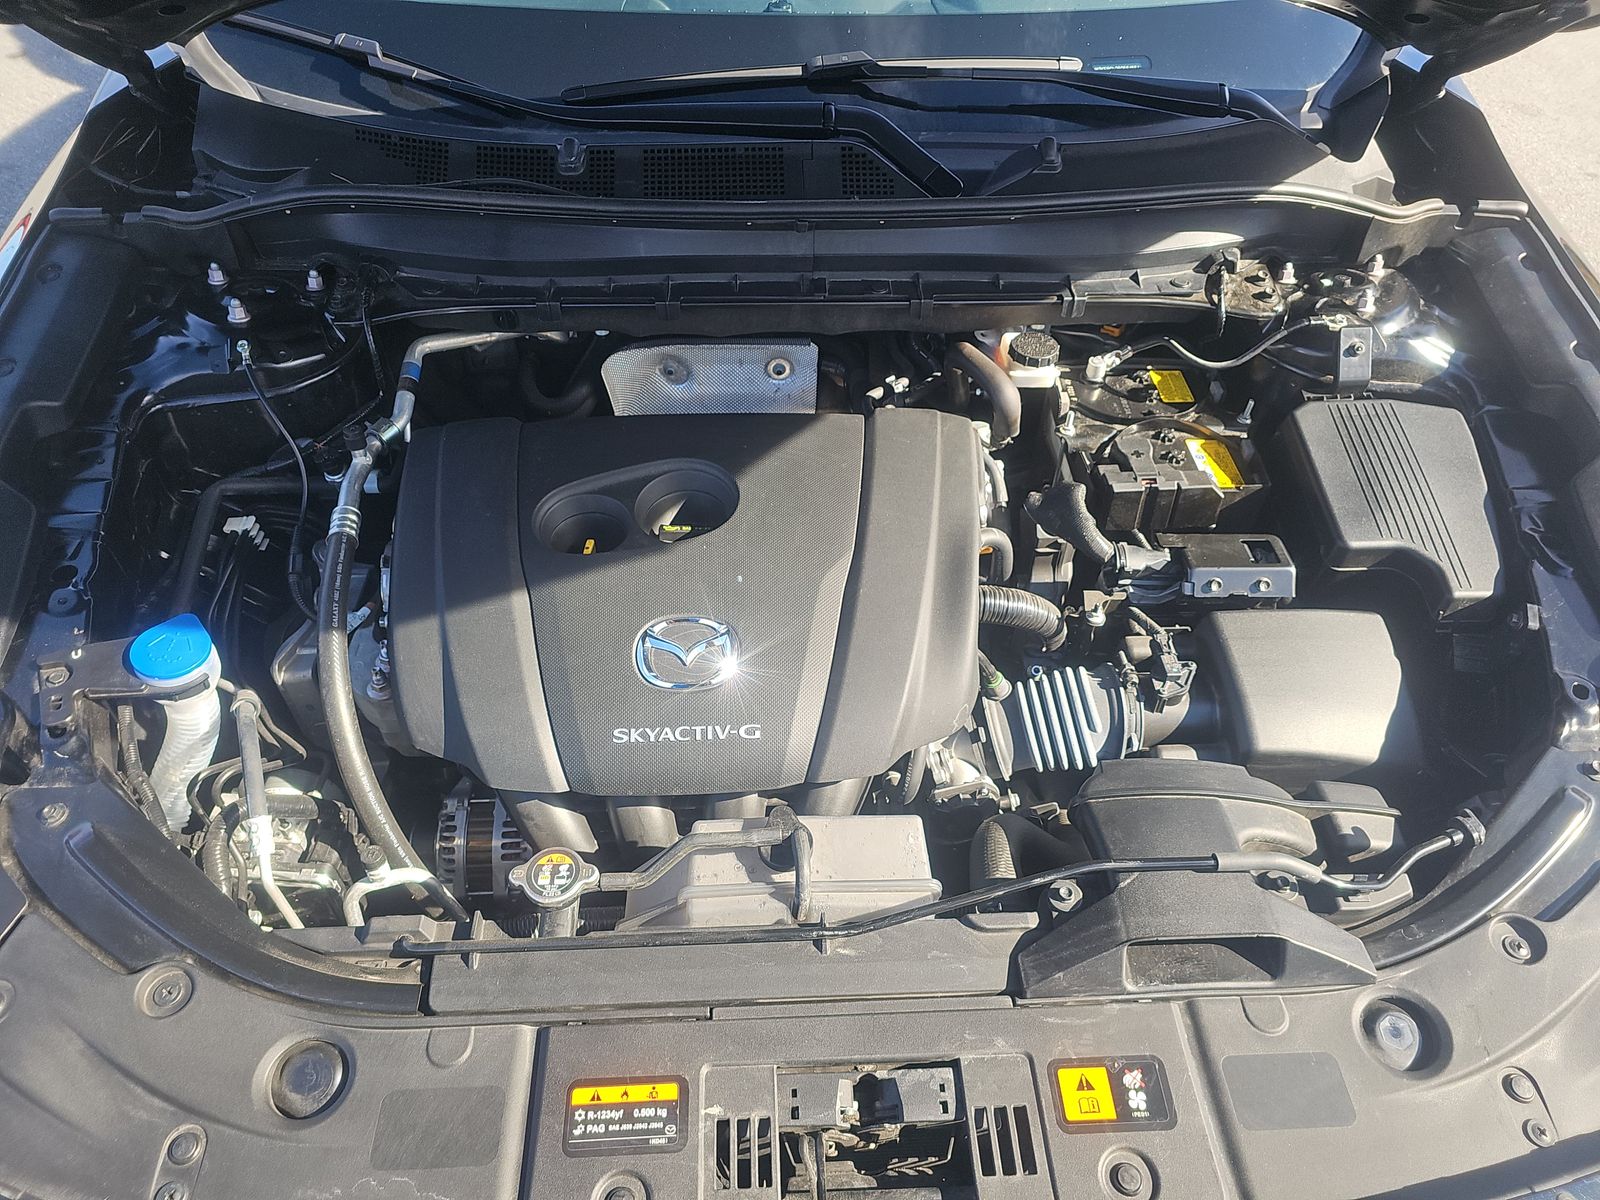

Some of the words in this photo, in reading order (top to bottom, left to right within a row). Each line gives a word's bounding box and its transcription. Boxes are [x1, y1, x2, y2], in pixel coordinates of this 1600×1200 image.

[612, 724, 762, 744] SKYACTIV-G
[587, 1108, 624, 1121] R-1234yf
[656, 1106, 668, 1118] kg
[586, 1124, 605, 1134] PAG
